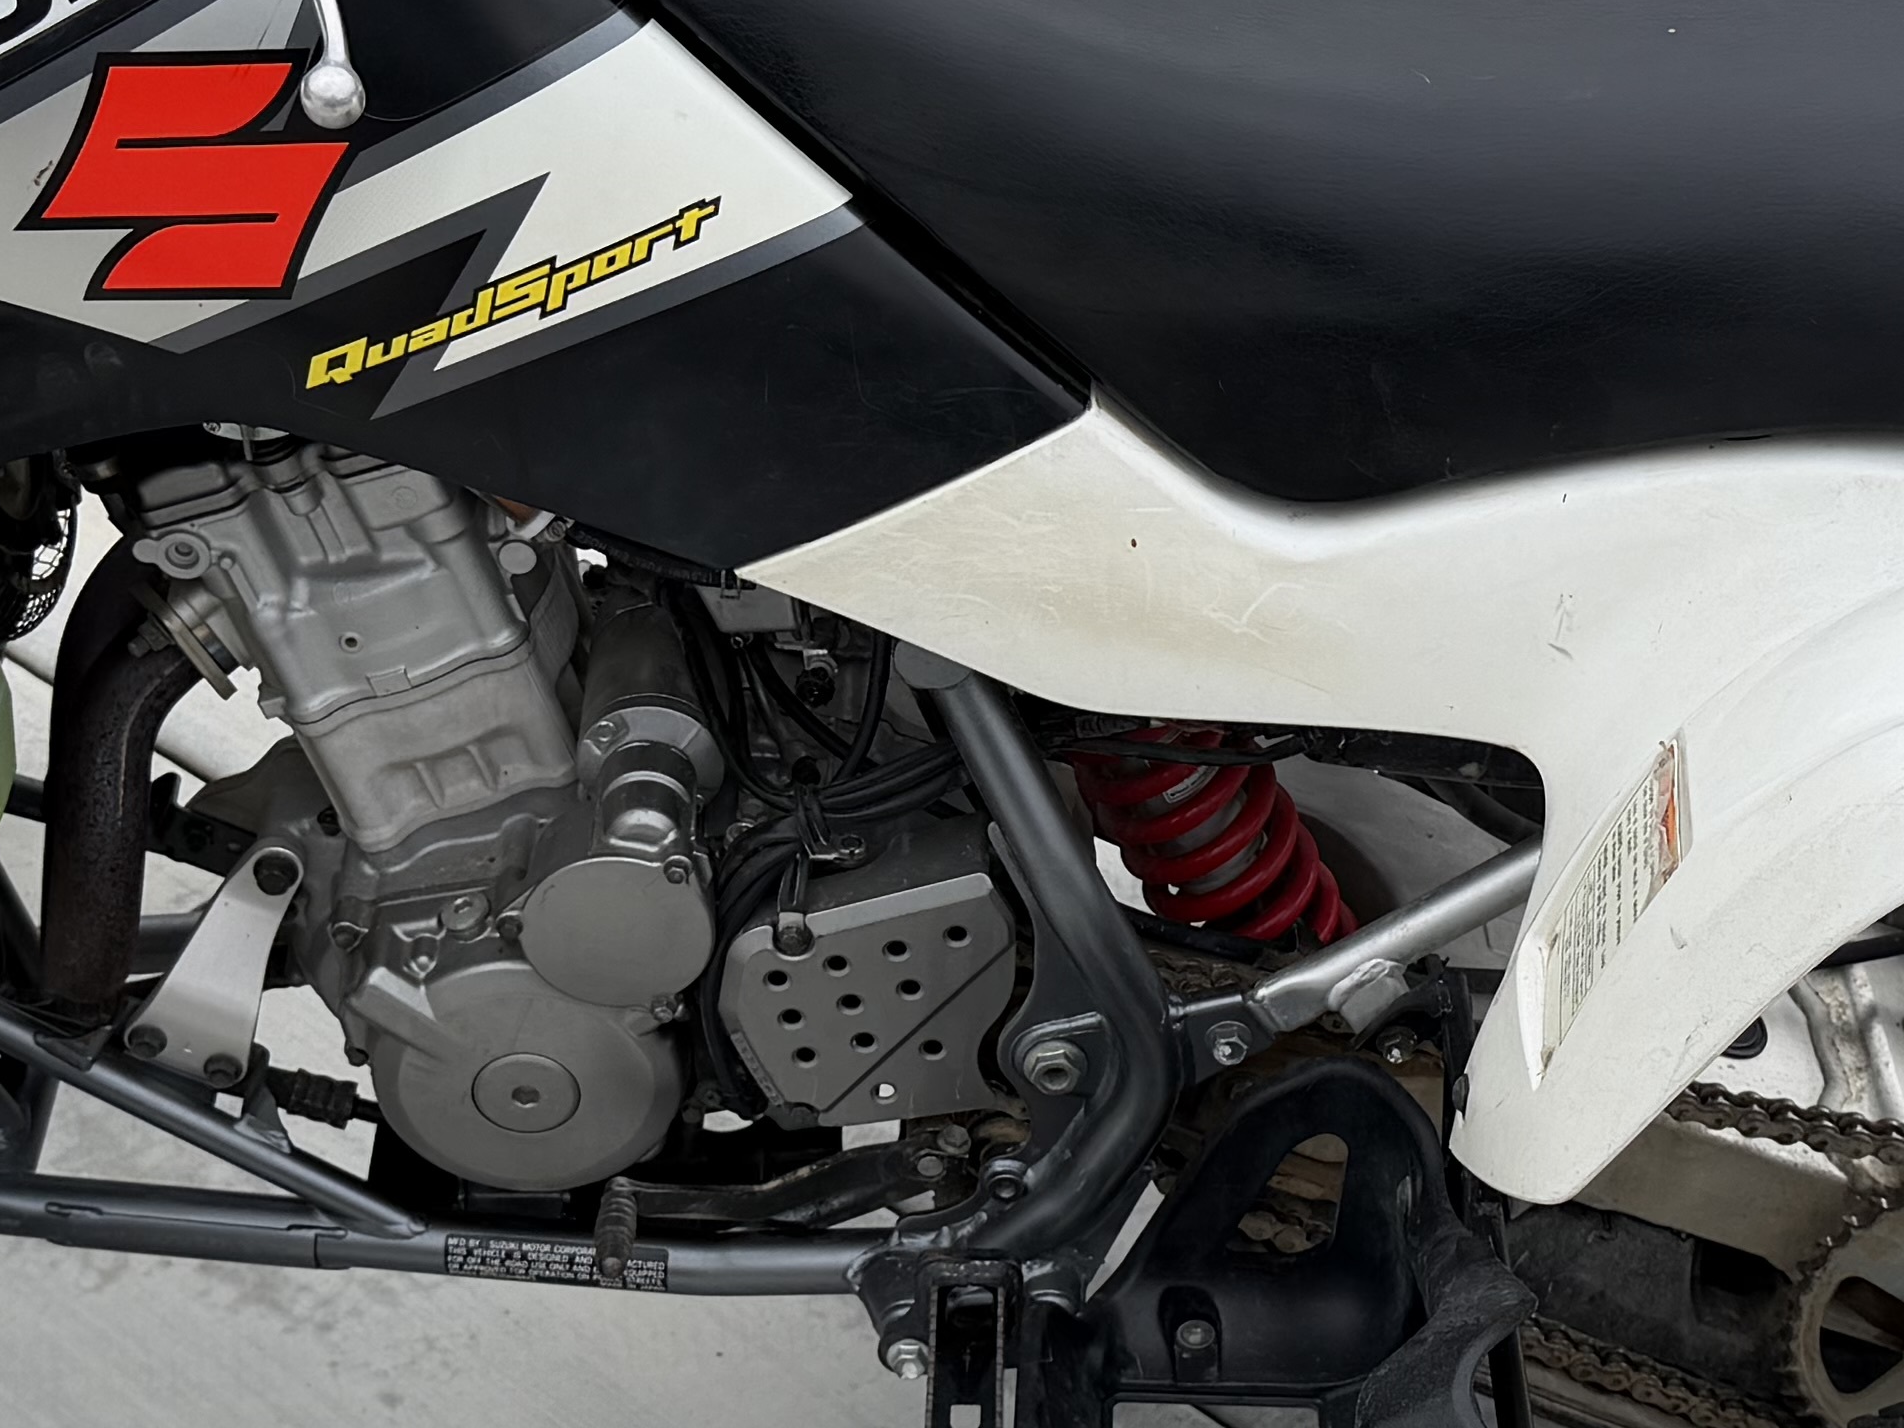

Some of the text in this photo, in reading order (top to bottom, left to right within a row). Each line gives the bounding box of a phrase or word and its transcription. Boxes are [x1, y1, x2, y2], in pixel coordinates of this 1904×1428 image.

[304, 195, 723, 392] QuadSport
[489, 1239, 519, 1249] SUZUKI
[522, 1243, 551, 1253] MOTOR
[473, 1248, 506, 1258] VEHICLE
[528, 1252, 568, 1262] DESIGNED
[574, 1255, 593, 1264] AND
